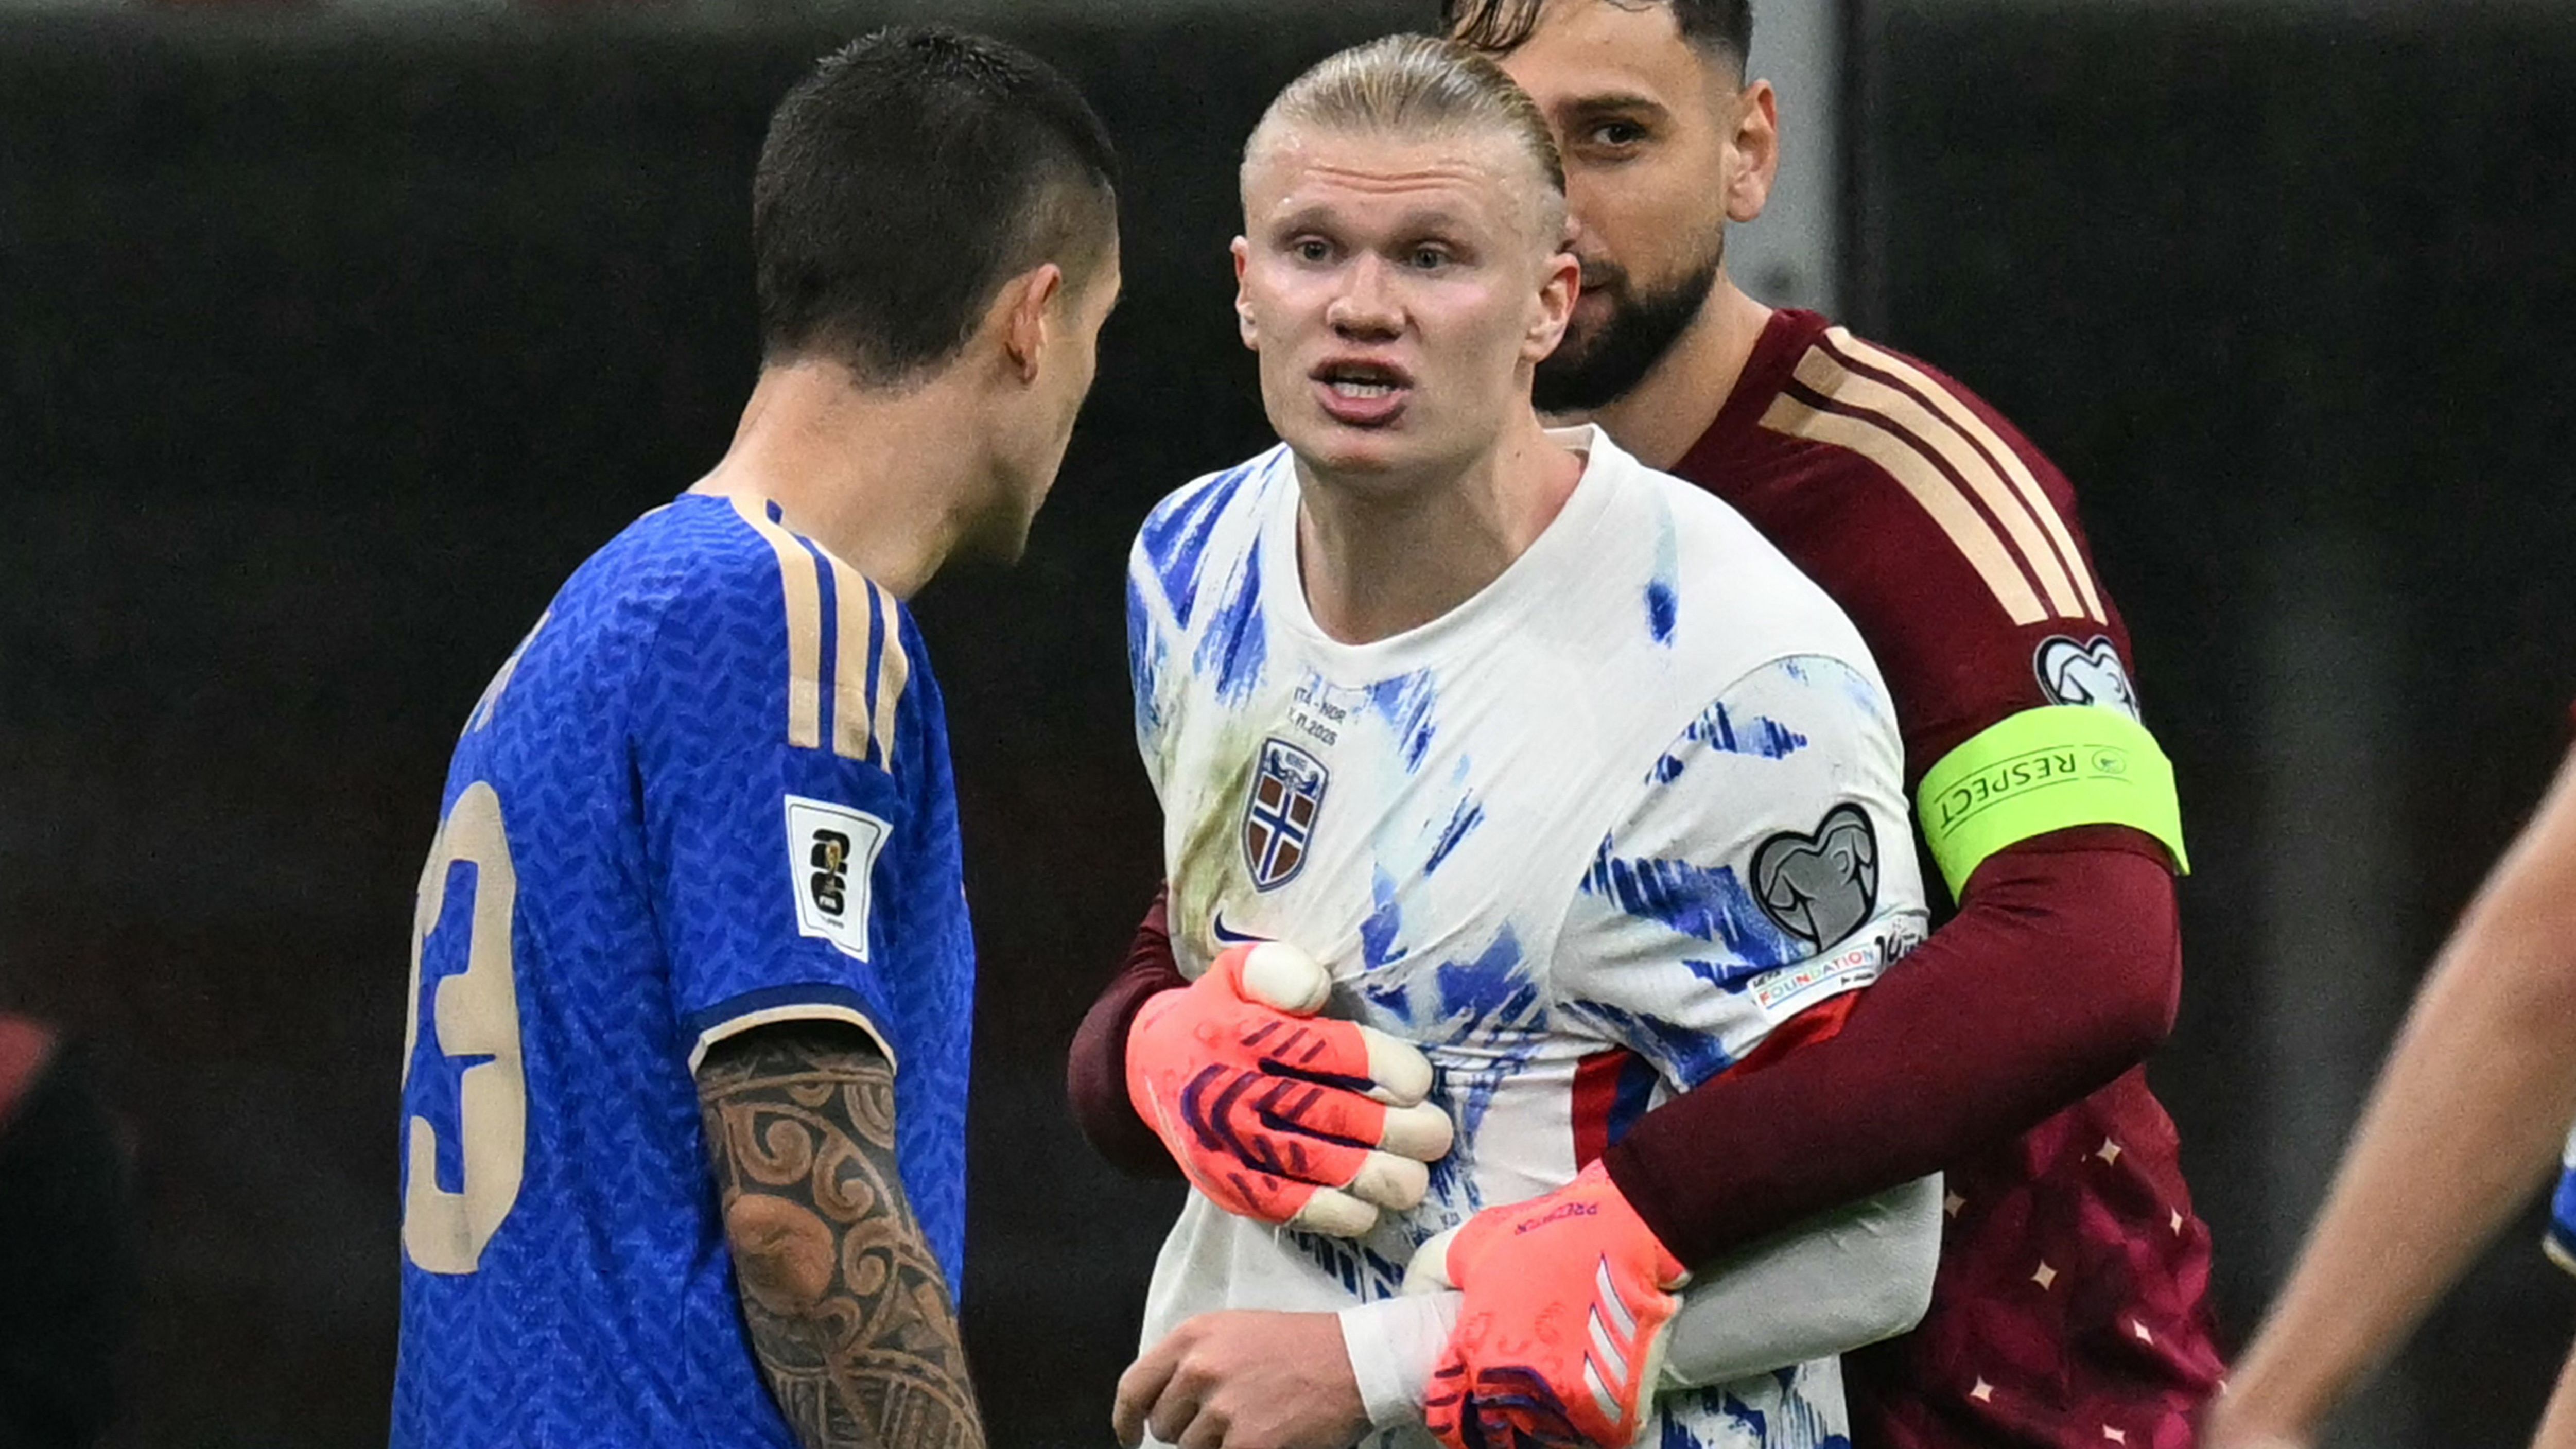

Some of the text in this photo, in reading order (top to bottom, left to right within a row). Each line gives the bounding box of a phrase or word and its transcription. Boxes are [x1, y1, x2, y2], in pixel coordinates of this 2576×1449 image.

[1294, 686, 1313, 706] ITA
[1319, 702, 1347, 725] NOR
[1940, 753, 2076, 830] RESPECT
[1759, 950, 1874, 1005] FOUNDATION
[401, 780, 527, 1275] 3
